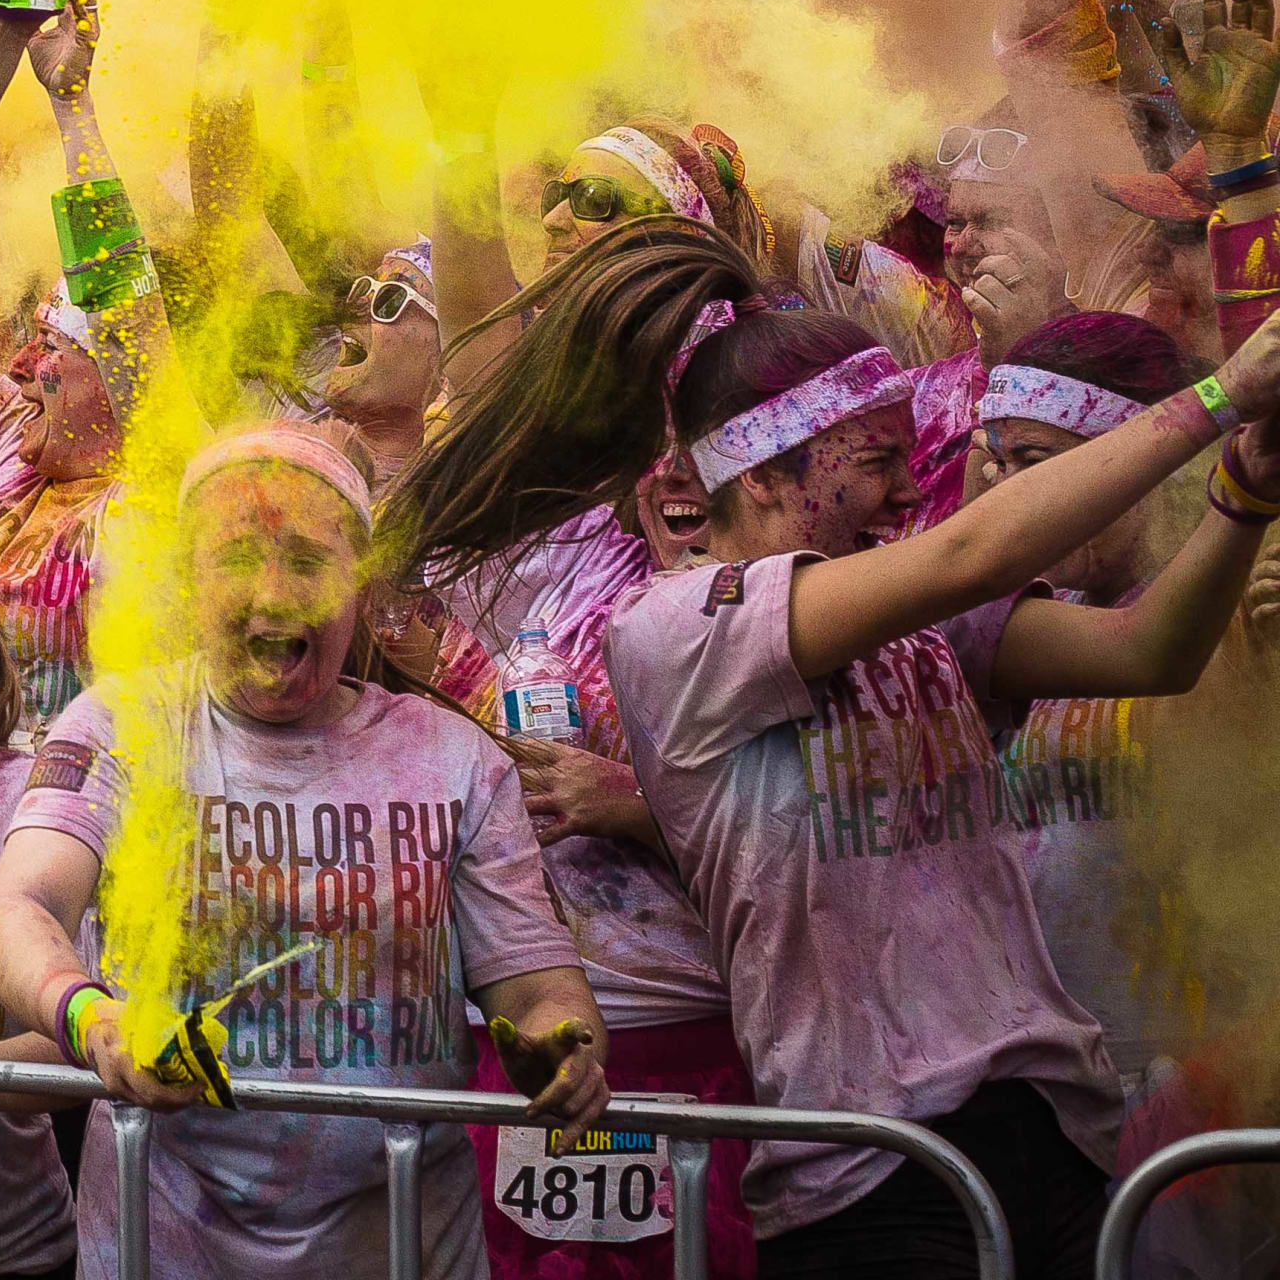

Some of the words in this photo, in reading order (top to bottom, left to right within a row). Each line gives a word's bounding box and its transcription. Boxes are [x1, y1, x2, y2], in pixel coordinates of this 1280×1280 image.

[843, 245, 857, 276] Swisse
[798, 722, 881, 795] THE
[226, 800, 376, 868] COLOR
[808, 776, 893, 863] THE
[228, 864, 377, 933] COLOR
[230, 927, 376, 1001] COLOR
[227, 997, 376, 1069] COLOR
